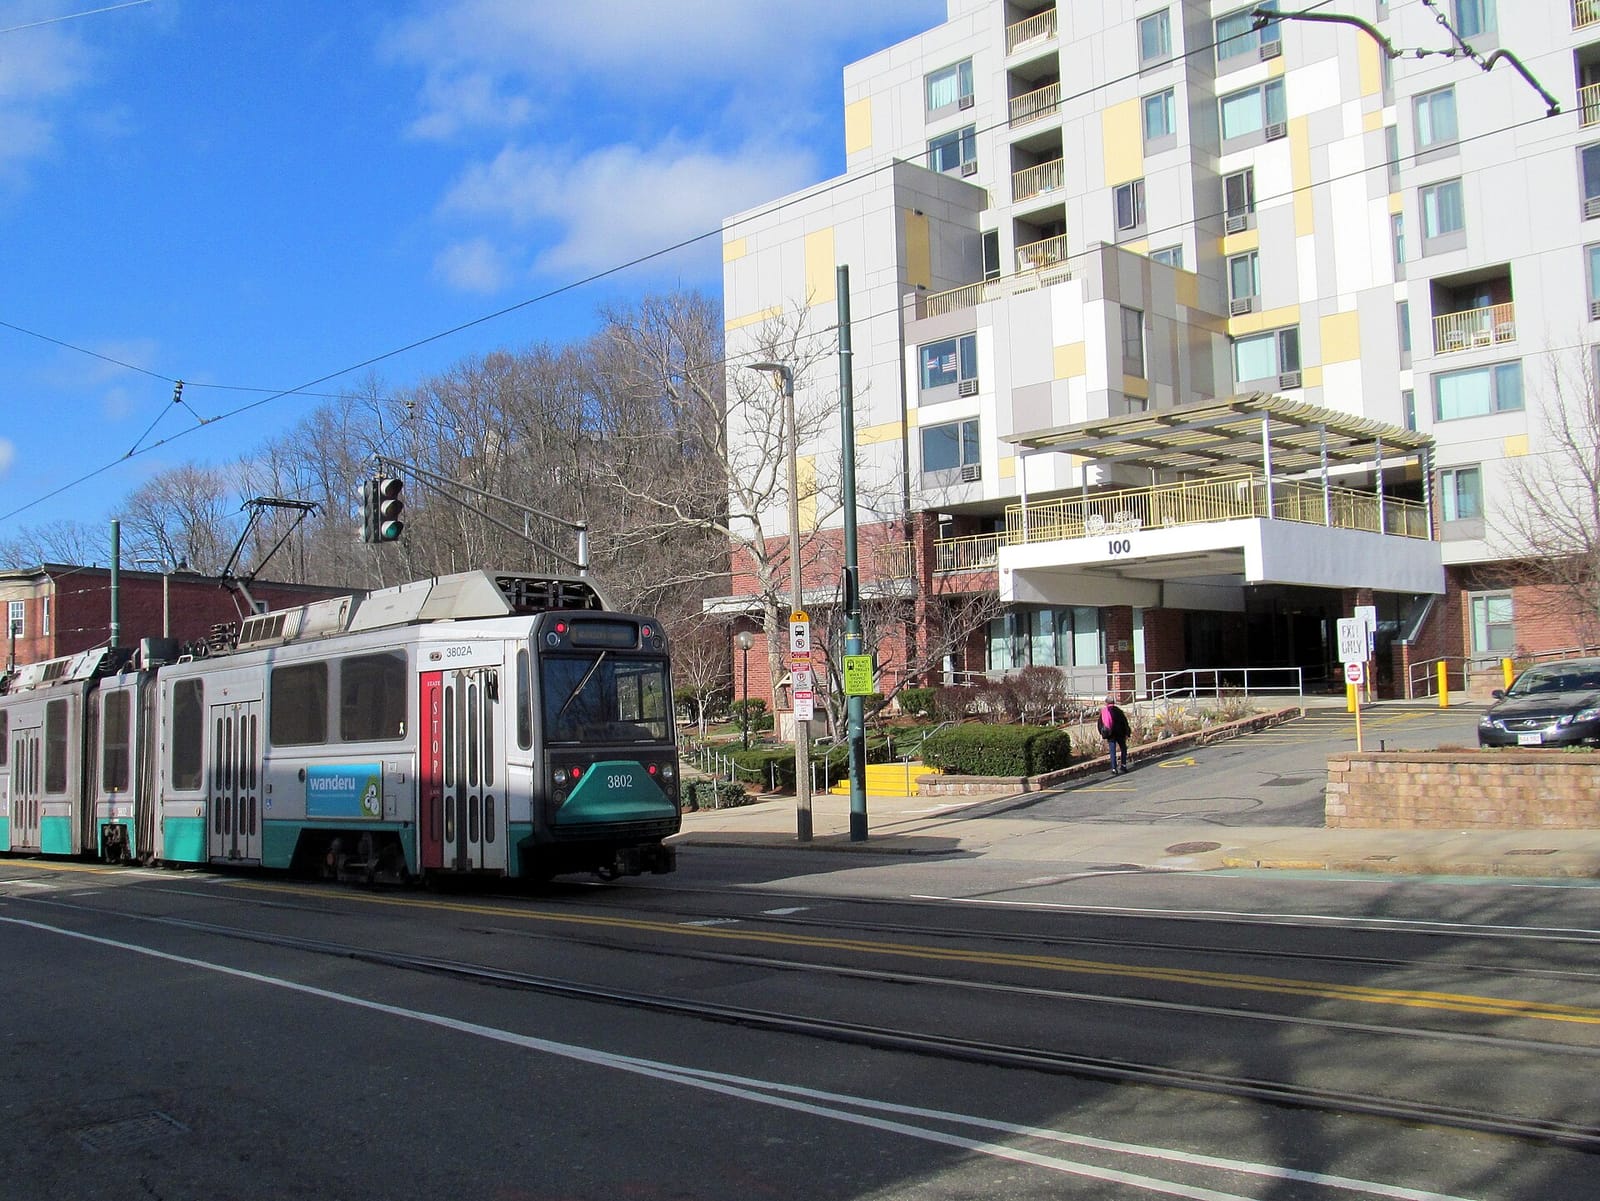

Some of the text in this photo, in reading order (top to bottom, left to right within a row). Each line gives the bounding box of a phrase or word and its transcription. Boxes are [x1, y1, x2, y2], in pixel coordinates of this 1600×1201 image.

[1108, 539, 1131, 555] 100
[1341, 624, 1360, 638] EXIT
[446, 645, 473, 658] 3802A
[1342, 639, 1361, 654] ONLY
[310, 774, 356, 791] wanderu
[607, 774, 633, 789] 3802
